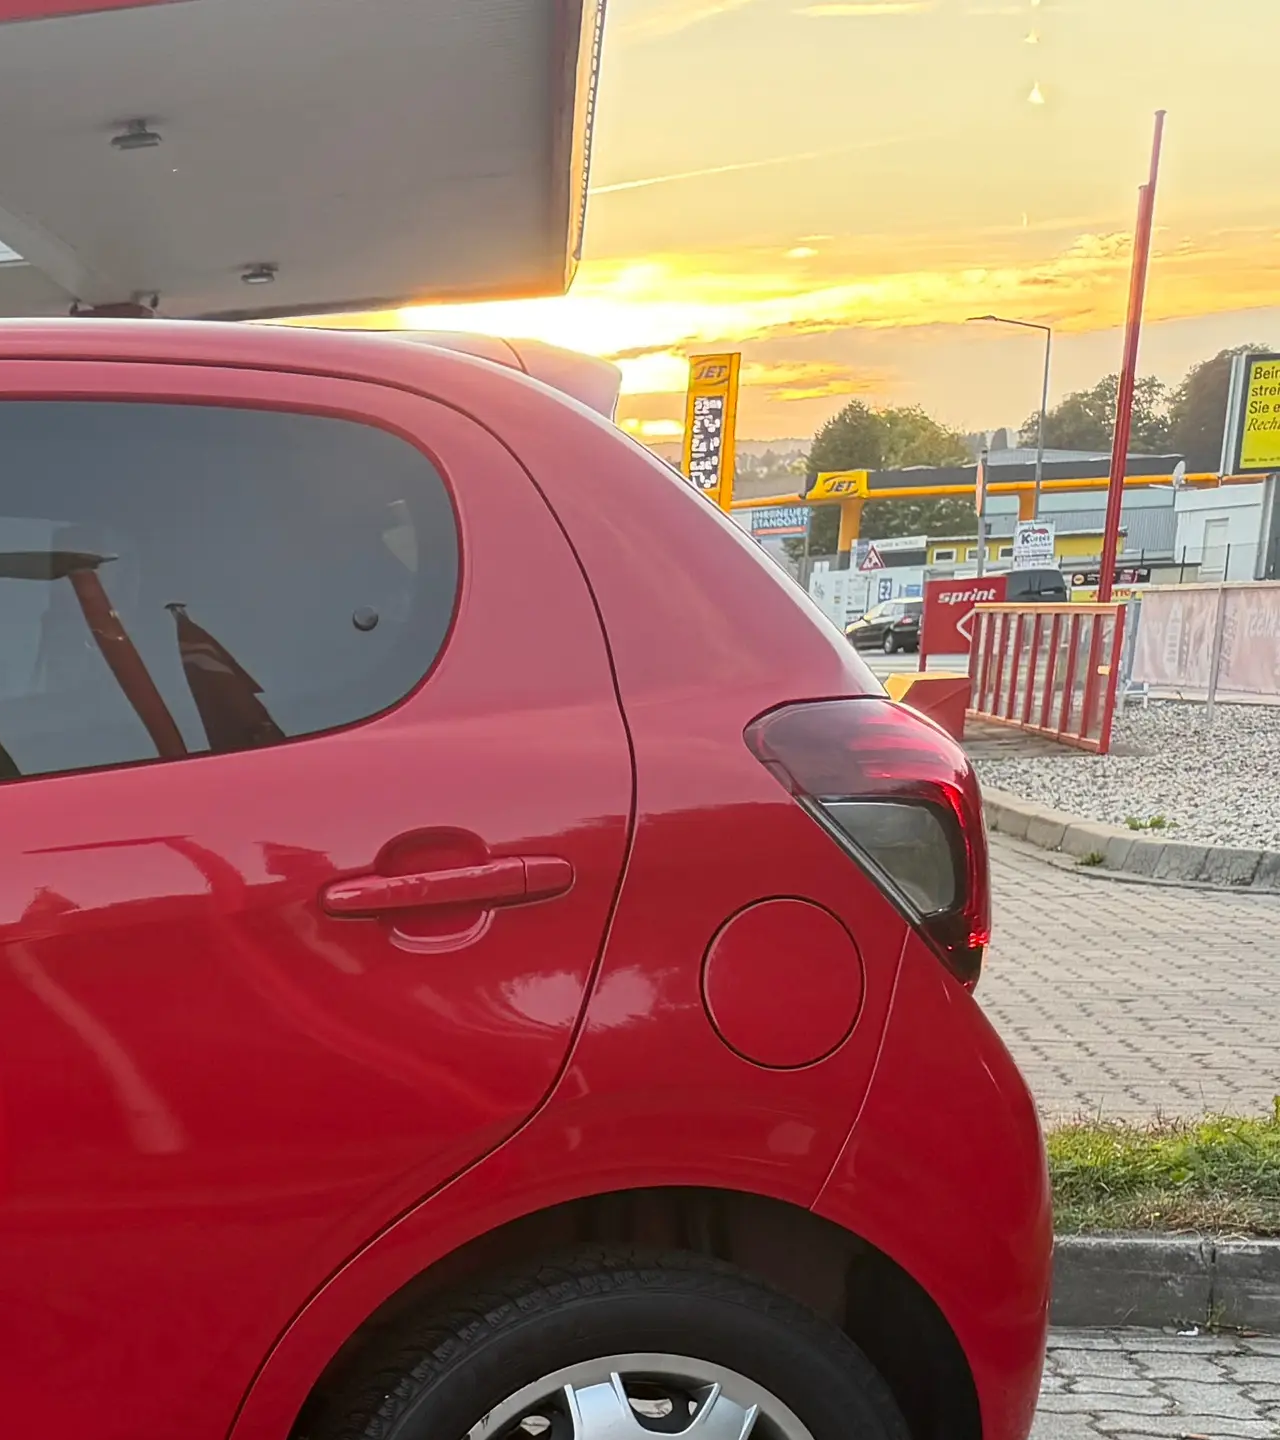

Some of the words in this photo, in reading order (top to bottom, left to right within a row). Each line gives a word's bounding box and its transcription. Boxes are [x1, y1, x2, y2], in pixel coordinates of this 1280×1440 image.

[695, 365, 728, 380] JET
[1249, 400, 1269, 415] Sie
[826, 480, 857, 493] JET
[938, 588, 997, 605] sprint
